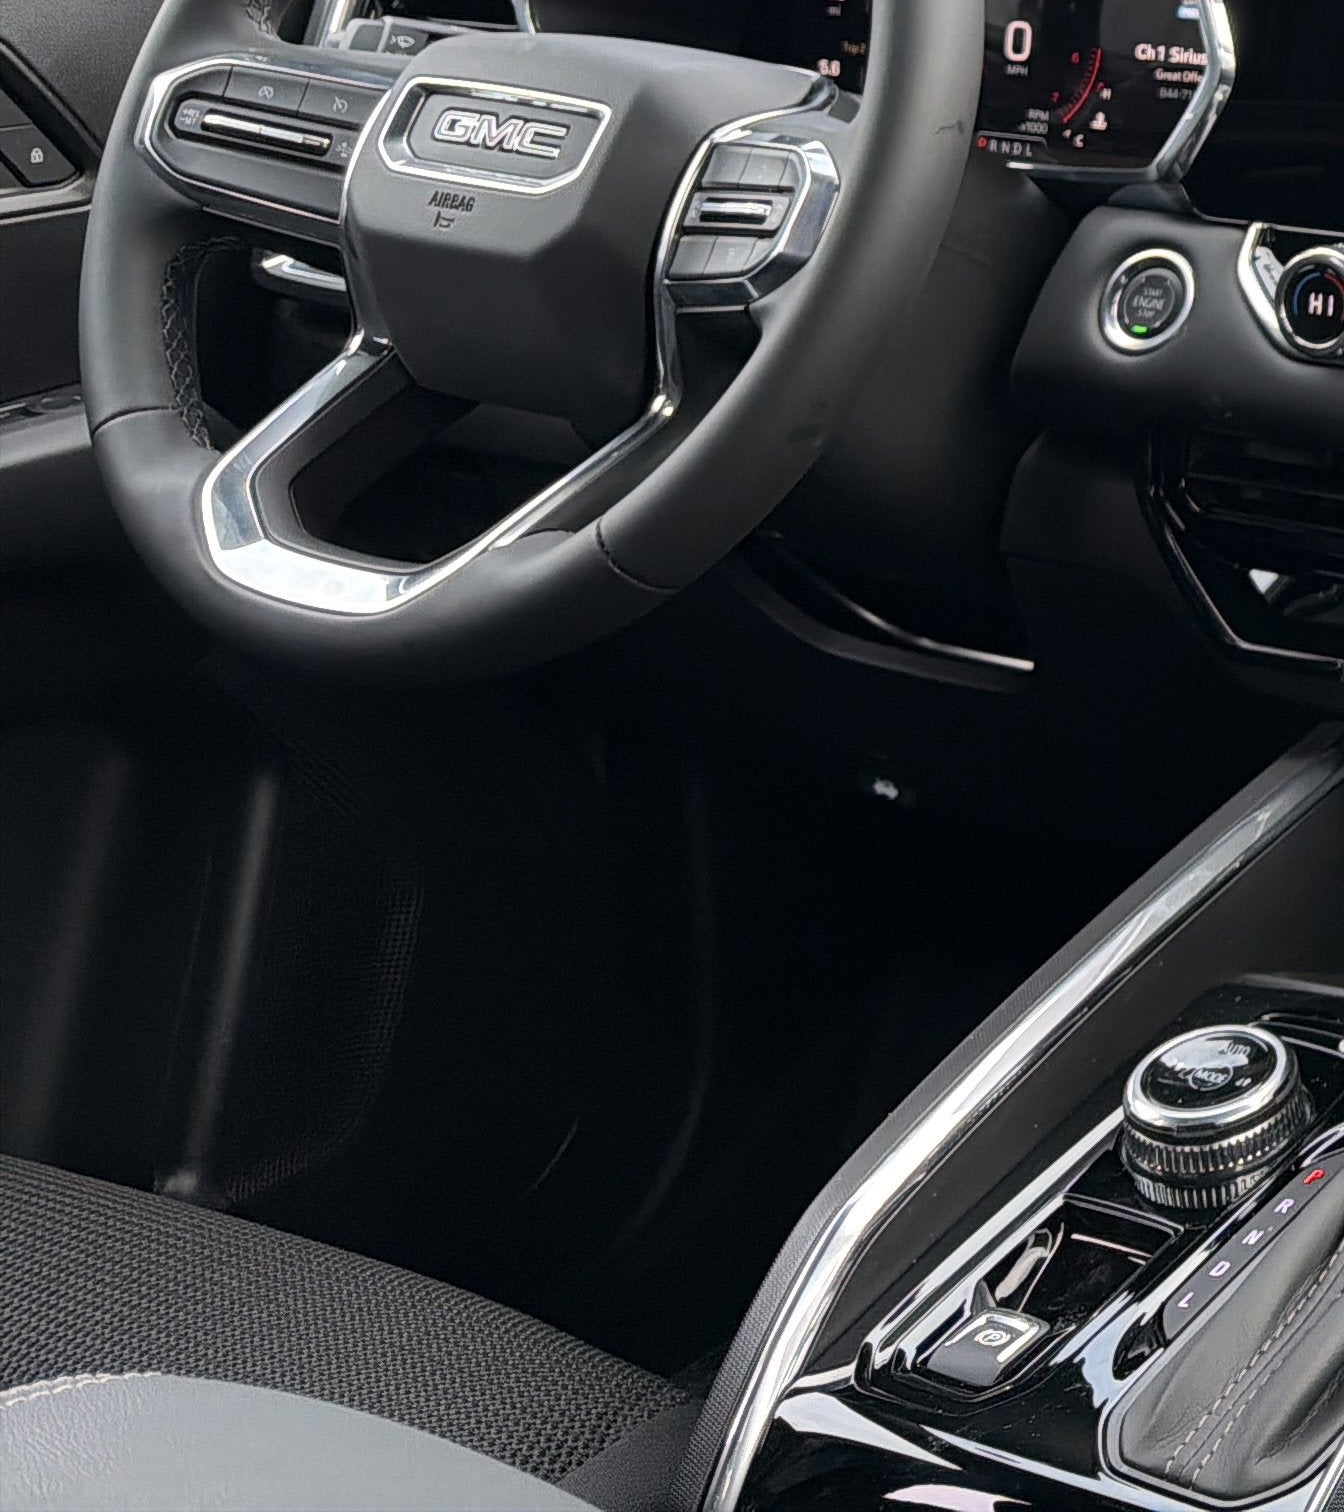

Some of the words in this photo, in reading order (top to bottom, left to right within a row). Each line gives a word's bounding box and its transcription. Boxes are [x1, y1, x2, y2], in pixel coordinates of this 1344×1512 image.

[1003, 20, 1033, 62] 0
[1006, 65, 1028, 76] MPH
[434, 107, 570, 161] GMC
[989, 139, 998, 152] R
[1001, 140, 1010, 154] N
[1012, 142, 1022, 155] D
[1025, 143, 1032, 157] L
[428, 190, 476, 212] AIRBAG
[1308, 292, 1334, 317] HI
[1303, 1169, 1325, 1186] P
[1273, 1198, 1295, 1214] R
[1241, 1230, 1264, 1245] N
[1209, 1261, 1231, 1276] D
[1177, 1291, 1194, 1308] L
